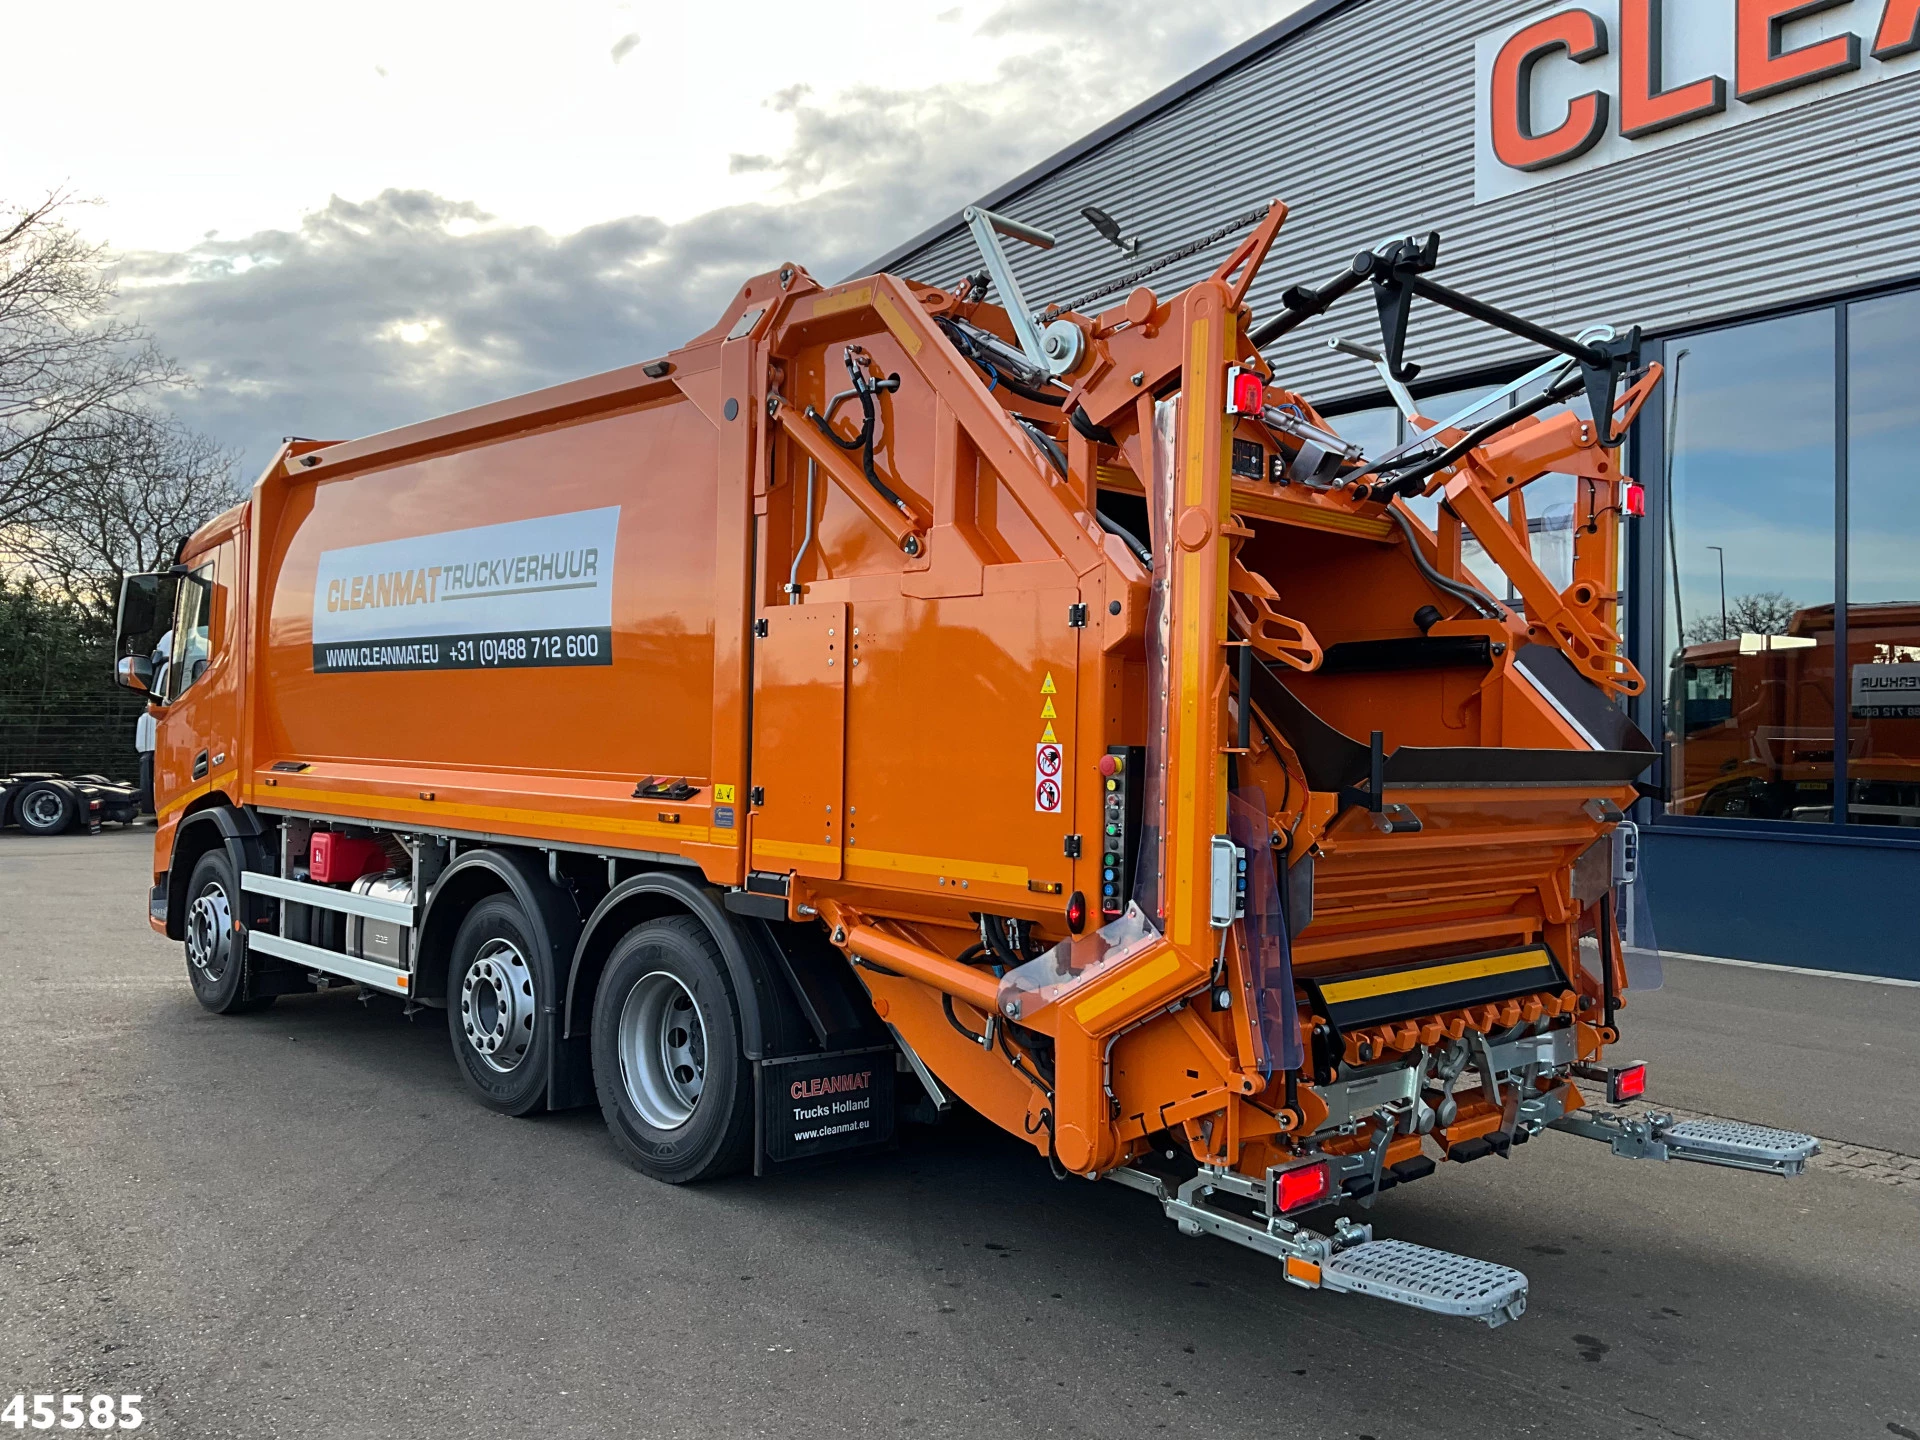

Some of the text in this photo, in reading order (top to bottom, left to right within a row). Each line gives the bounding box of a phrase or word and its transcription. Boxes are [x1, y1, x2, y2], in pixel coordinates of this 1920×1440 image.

[327, 548, 598, 613] CLEANMAT TRUCKVERHUUR
[326, 634, 599, 667] WWW.CLEANMAT.EU +31 (0)488 712 600
[791, 1072, 872, 1099] CLEANMAT
[793, 1097, 870, 1121] Trucks Holland
[794, 1120, 870, 1141] www.cleanmat.eu
